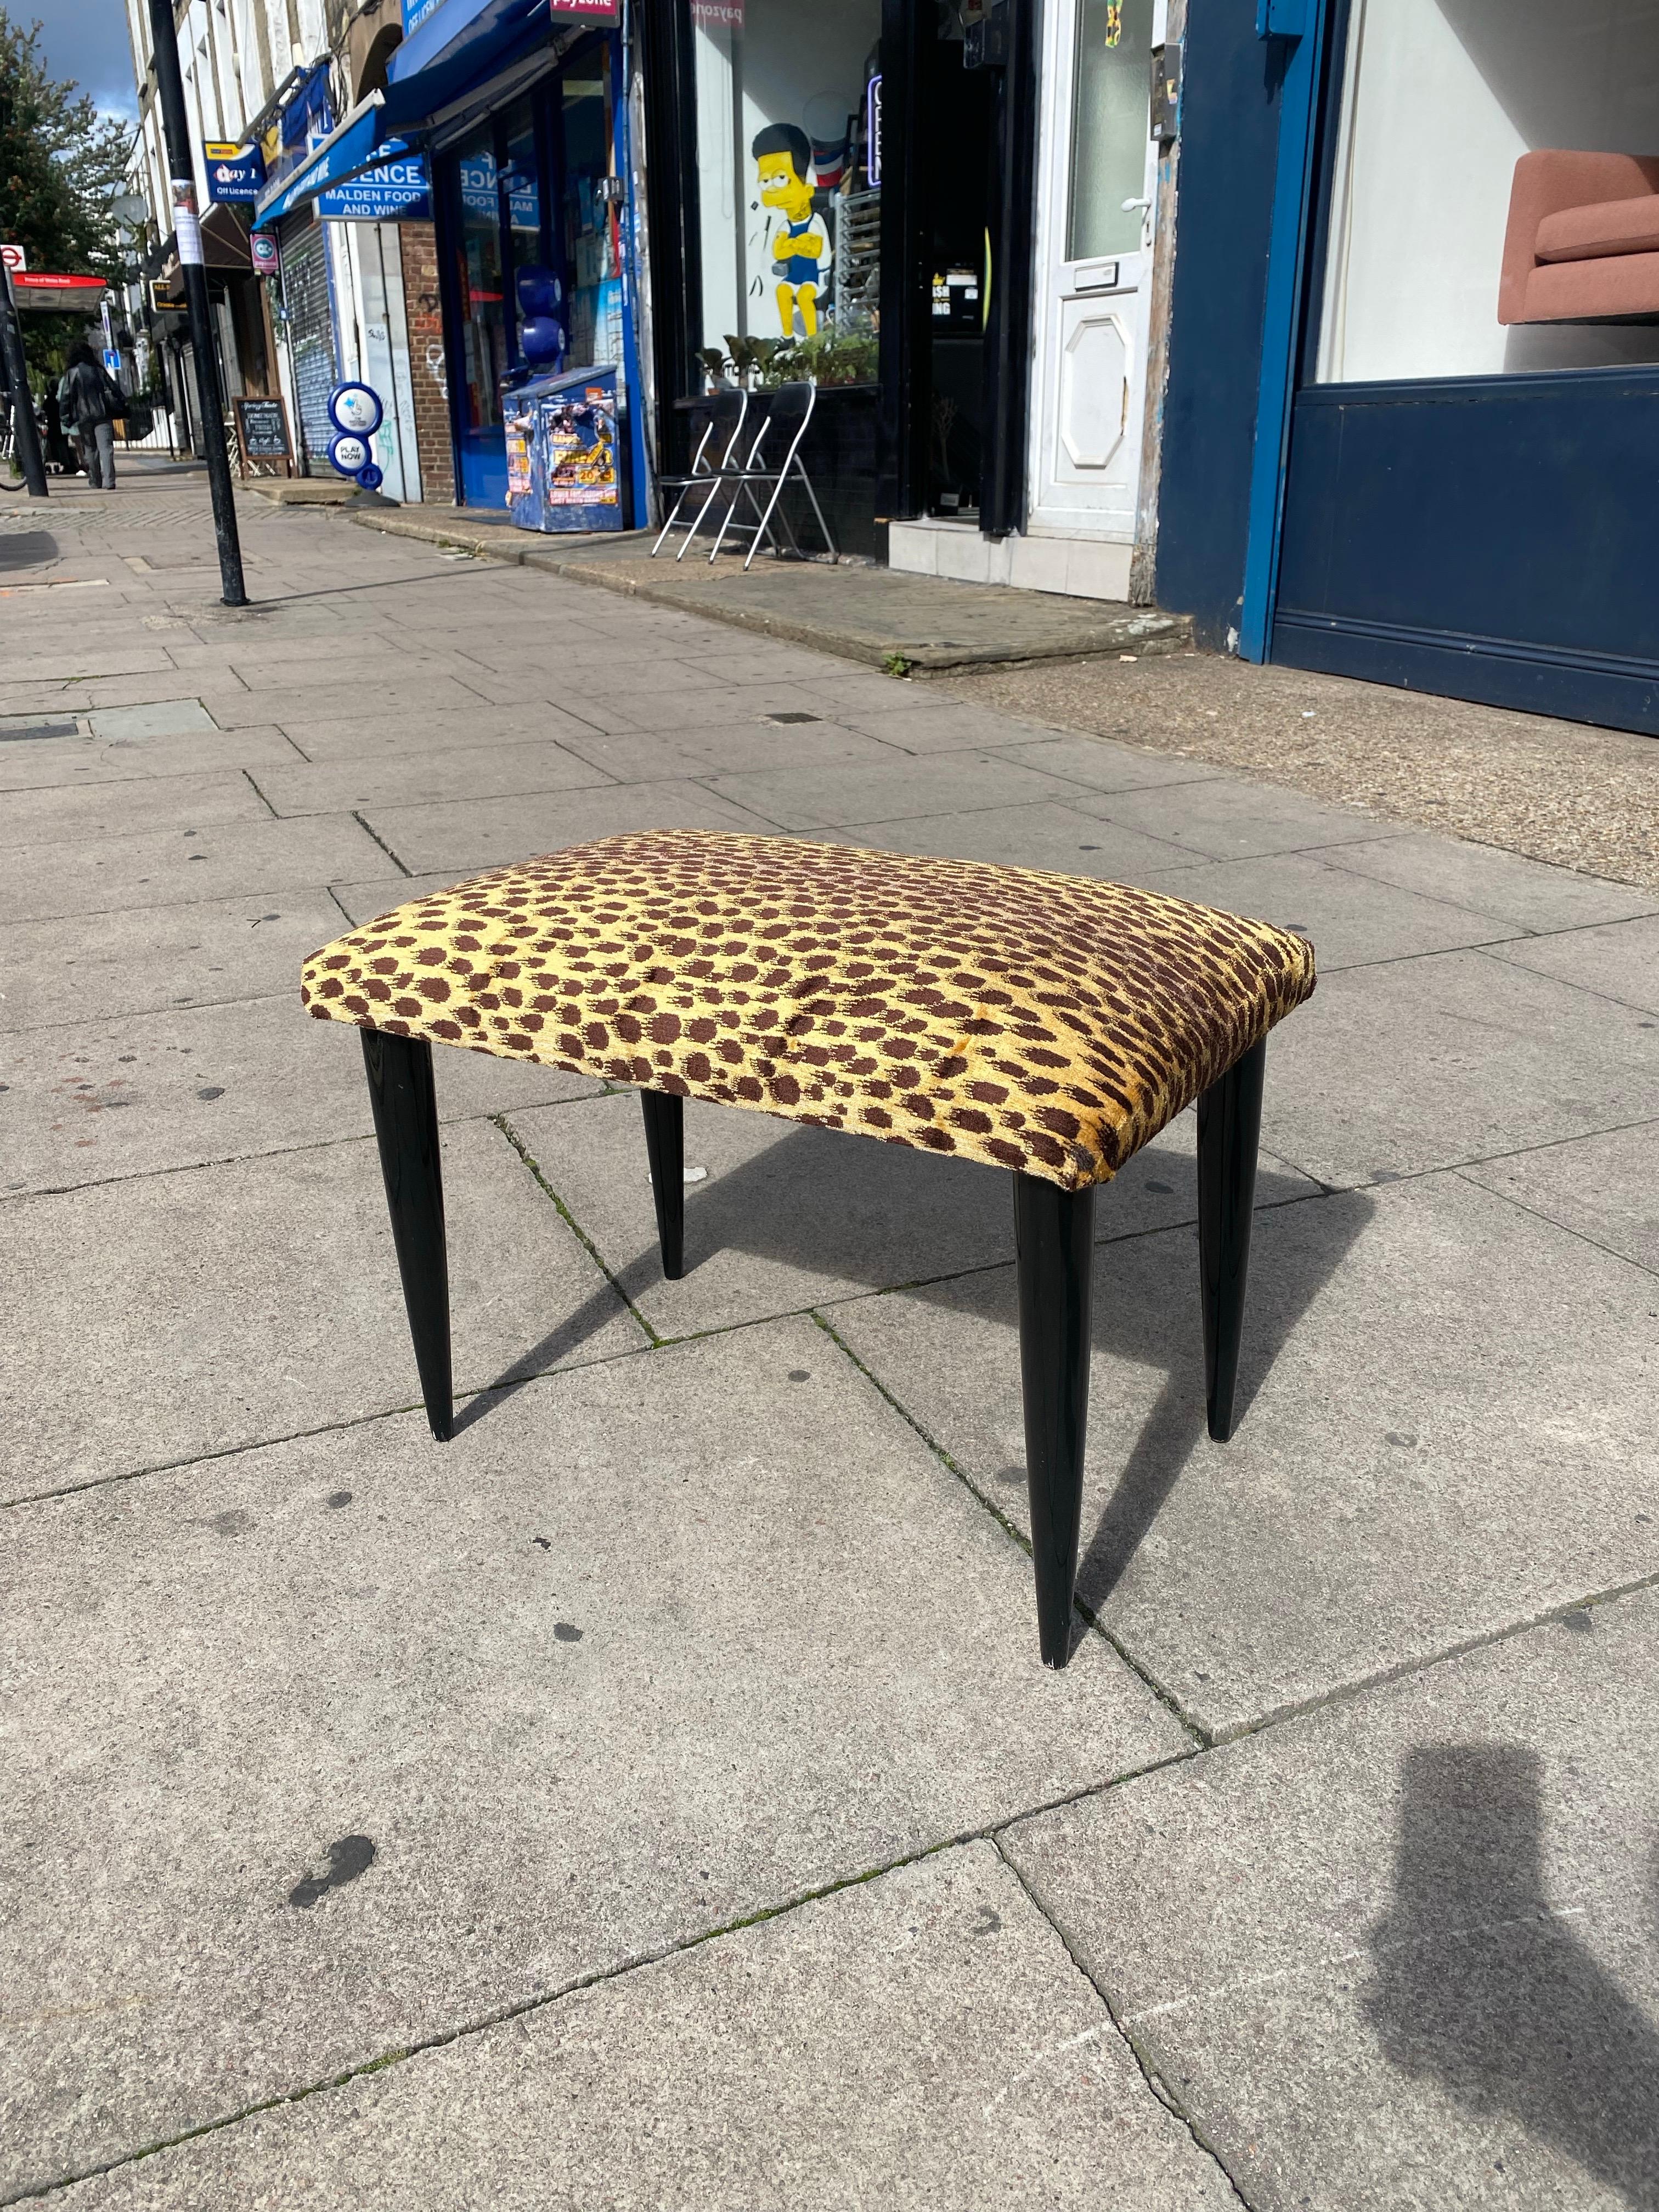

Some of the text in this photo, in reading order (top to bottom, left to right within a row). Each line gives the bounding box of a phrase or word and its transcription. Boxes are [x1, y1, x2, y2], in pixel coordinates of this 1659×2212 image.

[350, 164, 421, 184] ENCE
[325, 189, 420, 202] MALDEN FOOD
[342, 204, 407, 216] AND WINE
